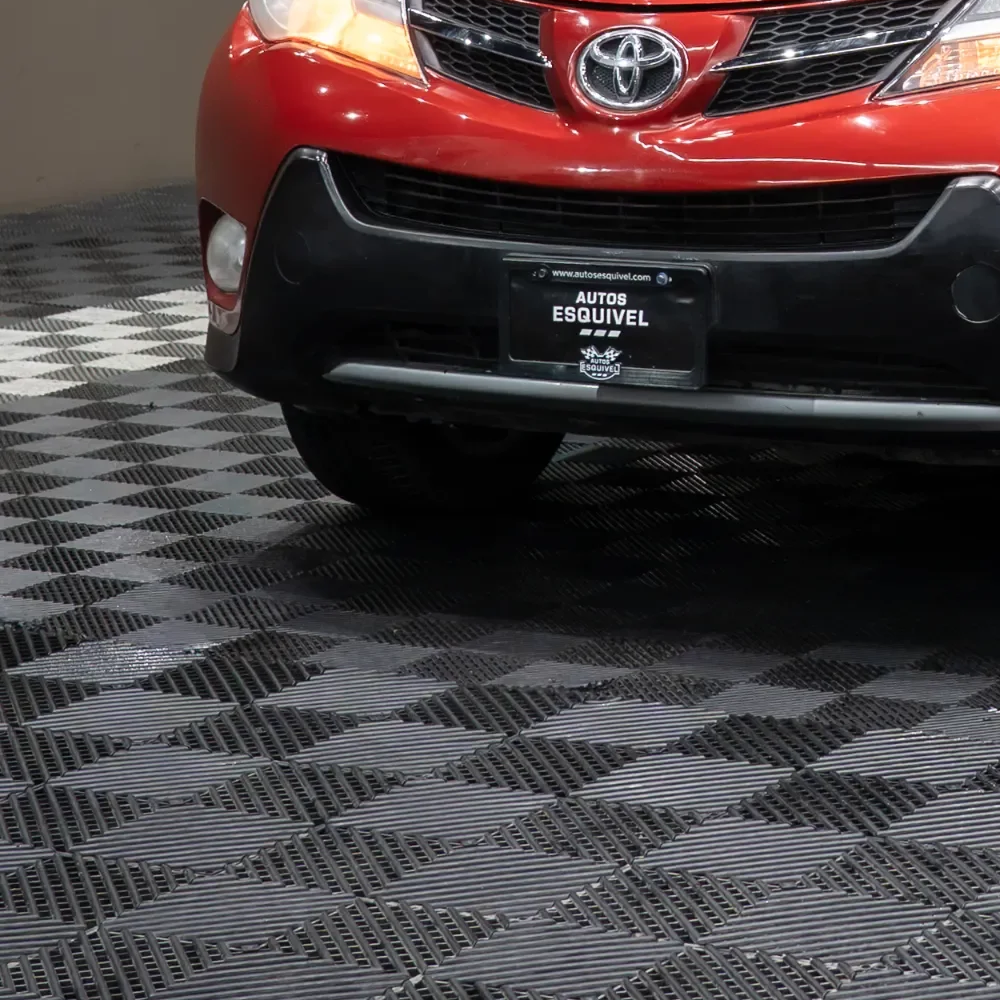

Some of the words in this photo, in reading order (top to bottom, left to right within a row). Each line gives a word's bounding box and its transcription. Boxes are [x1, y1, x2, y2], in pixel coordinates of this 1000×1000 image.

[552, 269, 652, 281] www.autosesquivel.com
[575, 290, 627, 306] AUTOS
[552, 305, 649, 327] ESQUIVEL
[582, 363, 618, 373] ESQUIVEL
